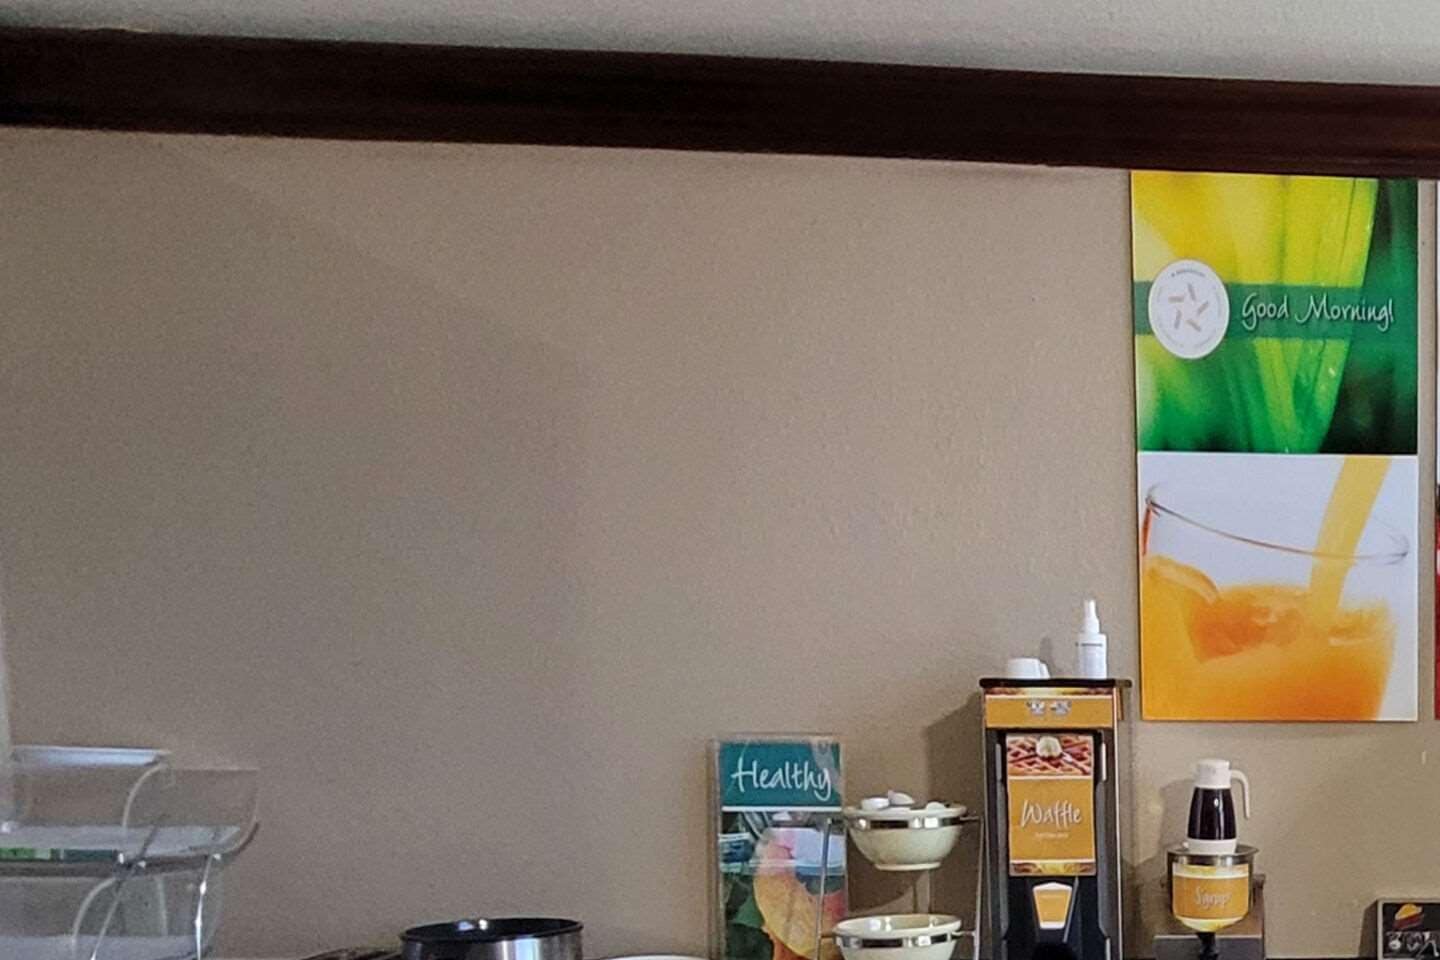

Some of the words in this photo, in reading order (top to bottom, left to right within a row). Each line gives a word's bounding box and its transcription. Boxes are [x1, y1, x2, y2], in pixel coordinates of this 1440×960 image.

[1241, 292, 1289, 331] Good
[1295, 293, 1394, 333] Morning!
[730, 757, 832, 802] Healthy
[1021, 799, 1083, 830] Waffle
